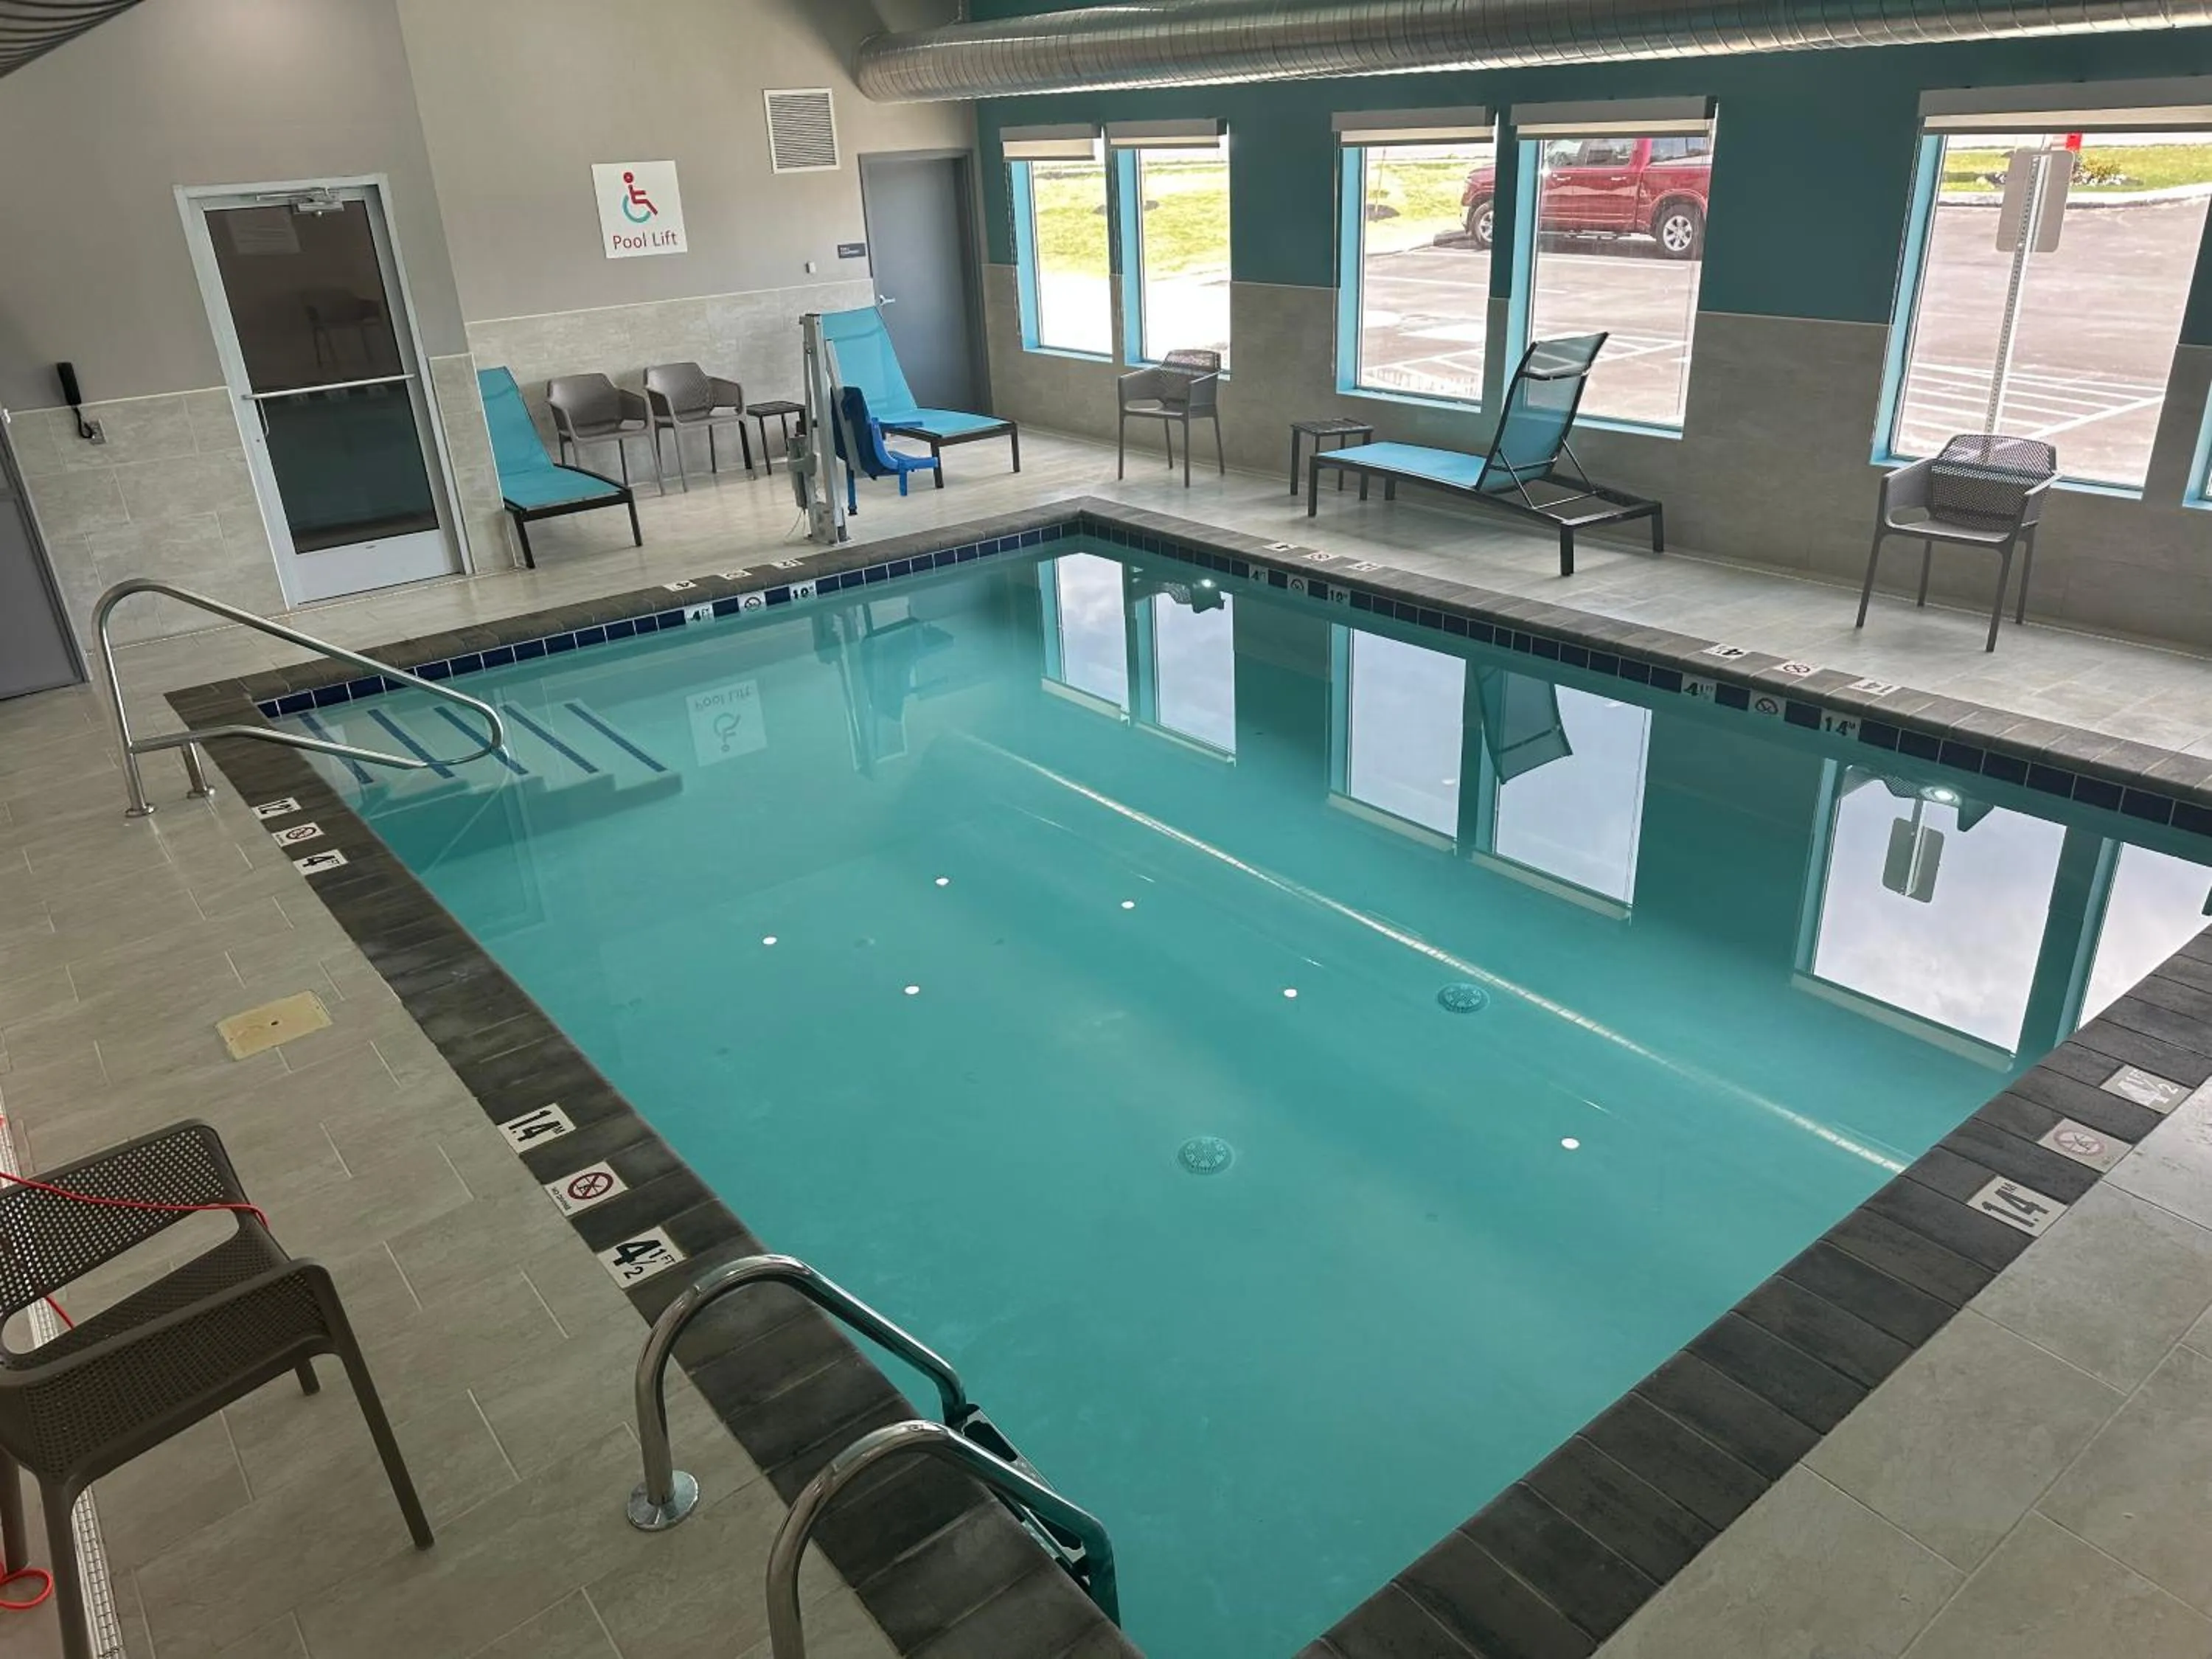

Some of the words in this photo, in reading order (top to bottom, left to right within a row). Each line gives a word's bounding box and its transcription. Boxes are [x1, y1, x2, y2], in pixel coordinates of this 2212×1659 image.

[613, 232, 647, 249] Pool
[652, 230, 678, 246] Lift
[302, 855, 335, 868] 4
